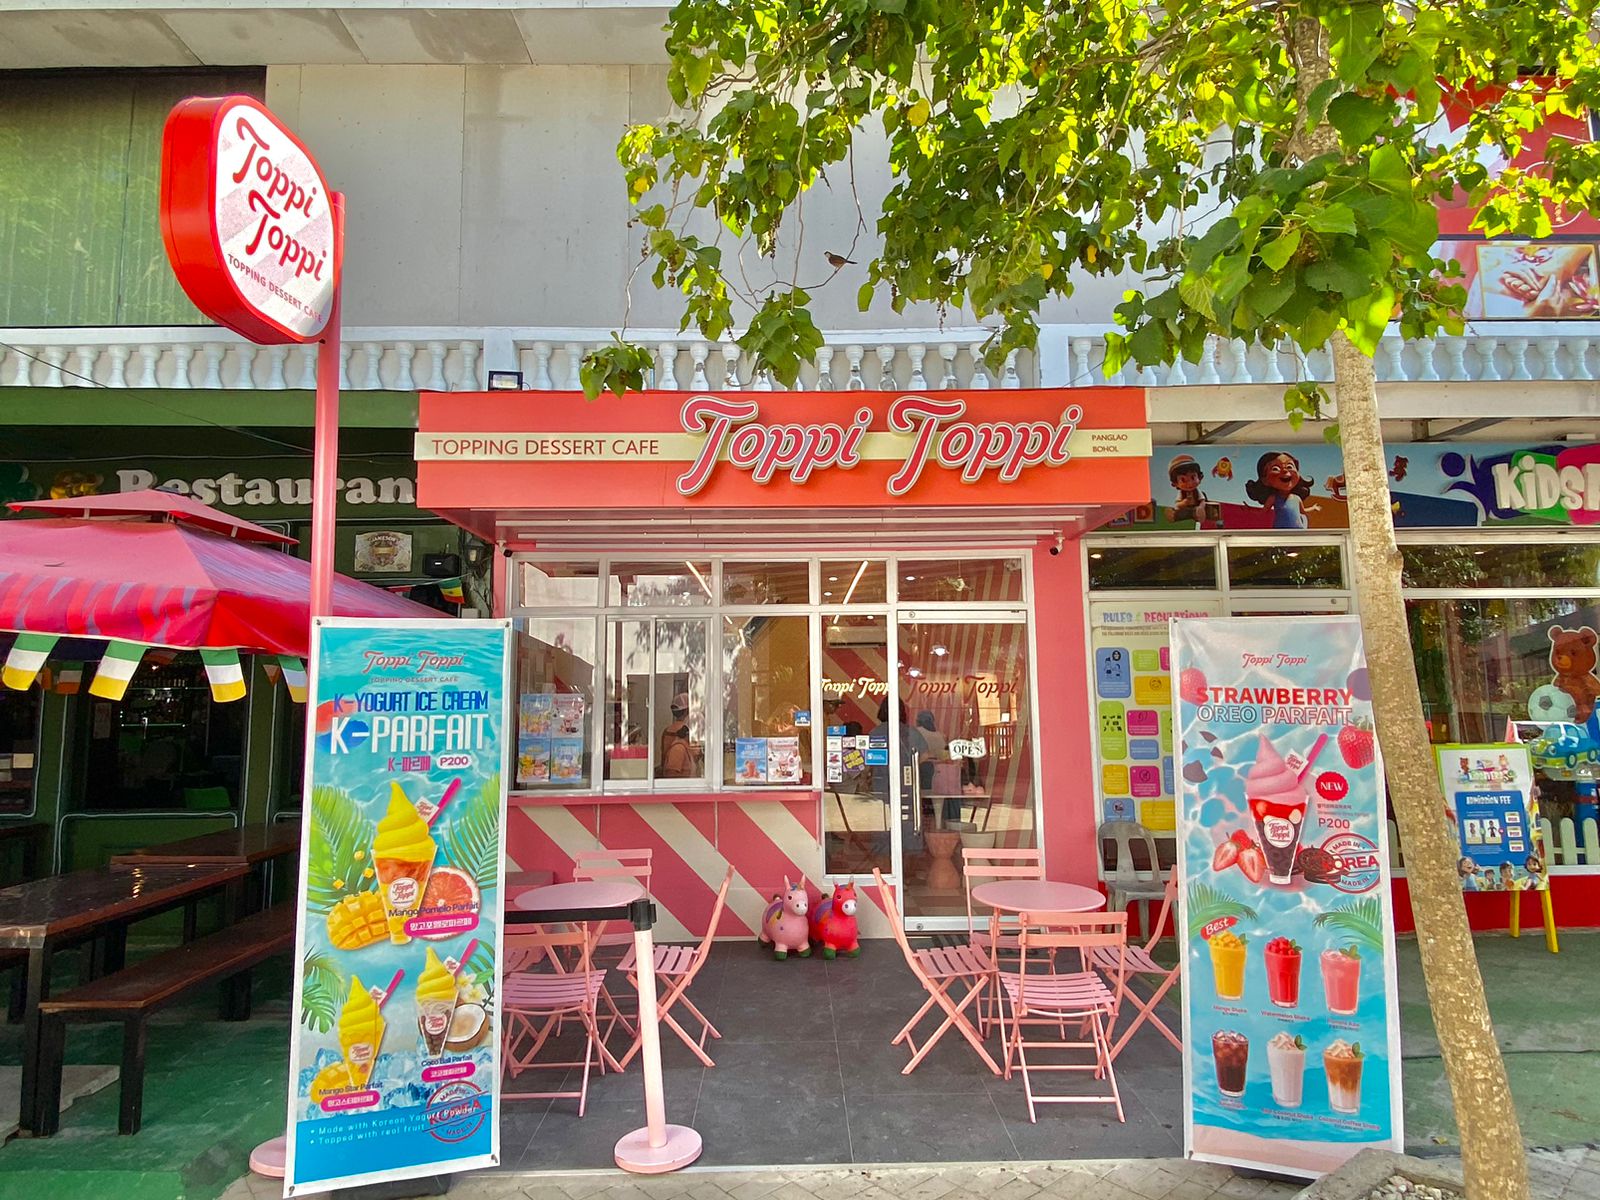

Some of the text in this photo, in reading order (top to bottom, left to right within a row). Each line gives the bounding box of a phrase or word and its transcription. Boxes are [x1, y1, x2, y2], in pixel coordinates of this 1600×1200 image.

[233, 117, 317, 218] Toppi
[246, 189, 327, 281] Toppi
[228, 253, 267, 287] TOPPING
[268, 281, 303, 311] DESSERT
[432, 395, 1083, 497] TOPPING DESSERT CAFE Toppi Toppi
[1091, 433, 1128, 442] PANGLAO
[1092, 445, 1119, 453] BOHOL
[116, 469, 417, 504] Restauan
[1103, 611, 1132, 622] RULES
[362, 650, 467, 674] Toppi Toppi
[1242, 653, 1310, 668] Toppi Toppi
[904, 675, 1019, 704] Toppi Toppi
[1196, 687, 1353, 705] STRAWBERRY
[333, 690, 489, 713] K-YOGURT ICE CREAM
[1197, 705, 1352, 725] OREO PARFAIT
[330, 713, 489, 755] K-PARFAIT
[953, 745, 983, 755] OPEN
[440, 756, 469, 766] P200
[1320, 781, 1344, 791] NEW
[1318, 817, 1350, 829] P200
[1332, 840, 1352, 850] MADE
[1341, 878, 1361, 887] MADE
[388, 908, 418, 918] Mango
[453, 901, 479, 911] Parfait
[1204, 917, 1229, 936] Best
[421, 1059, 439, 1067] Coco
[319, 1087, 344, 1096] Mango
[360, 1080, 383, 1090] Parfait
[319, 1126, 344, 1136] Made
[348, 1122, 369, 1132] with
[372, 1117, 405, 1128] Korean
[443, 1106, 478, 1119] Powder
[319, 1123, 425, 1146] Topped with real fruit
